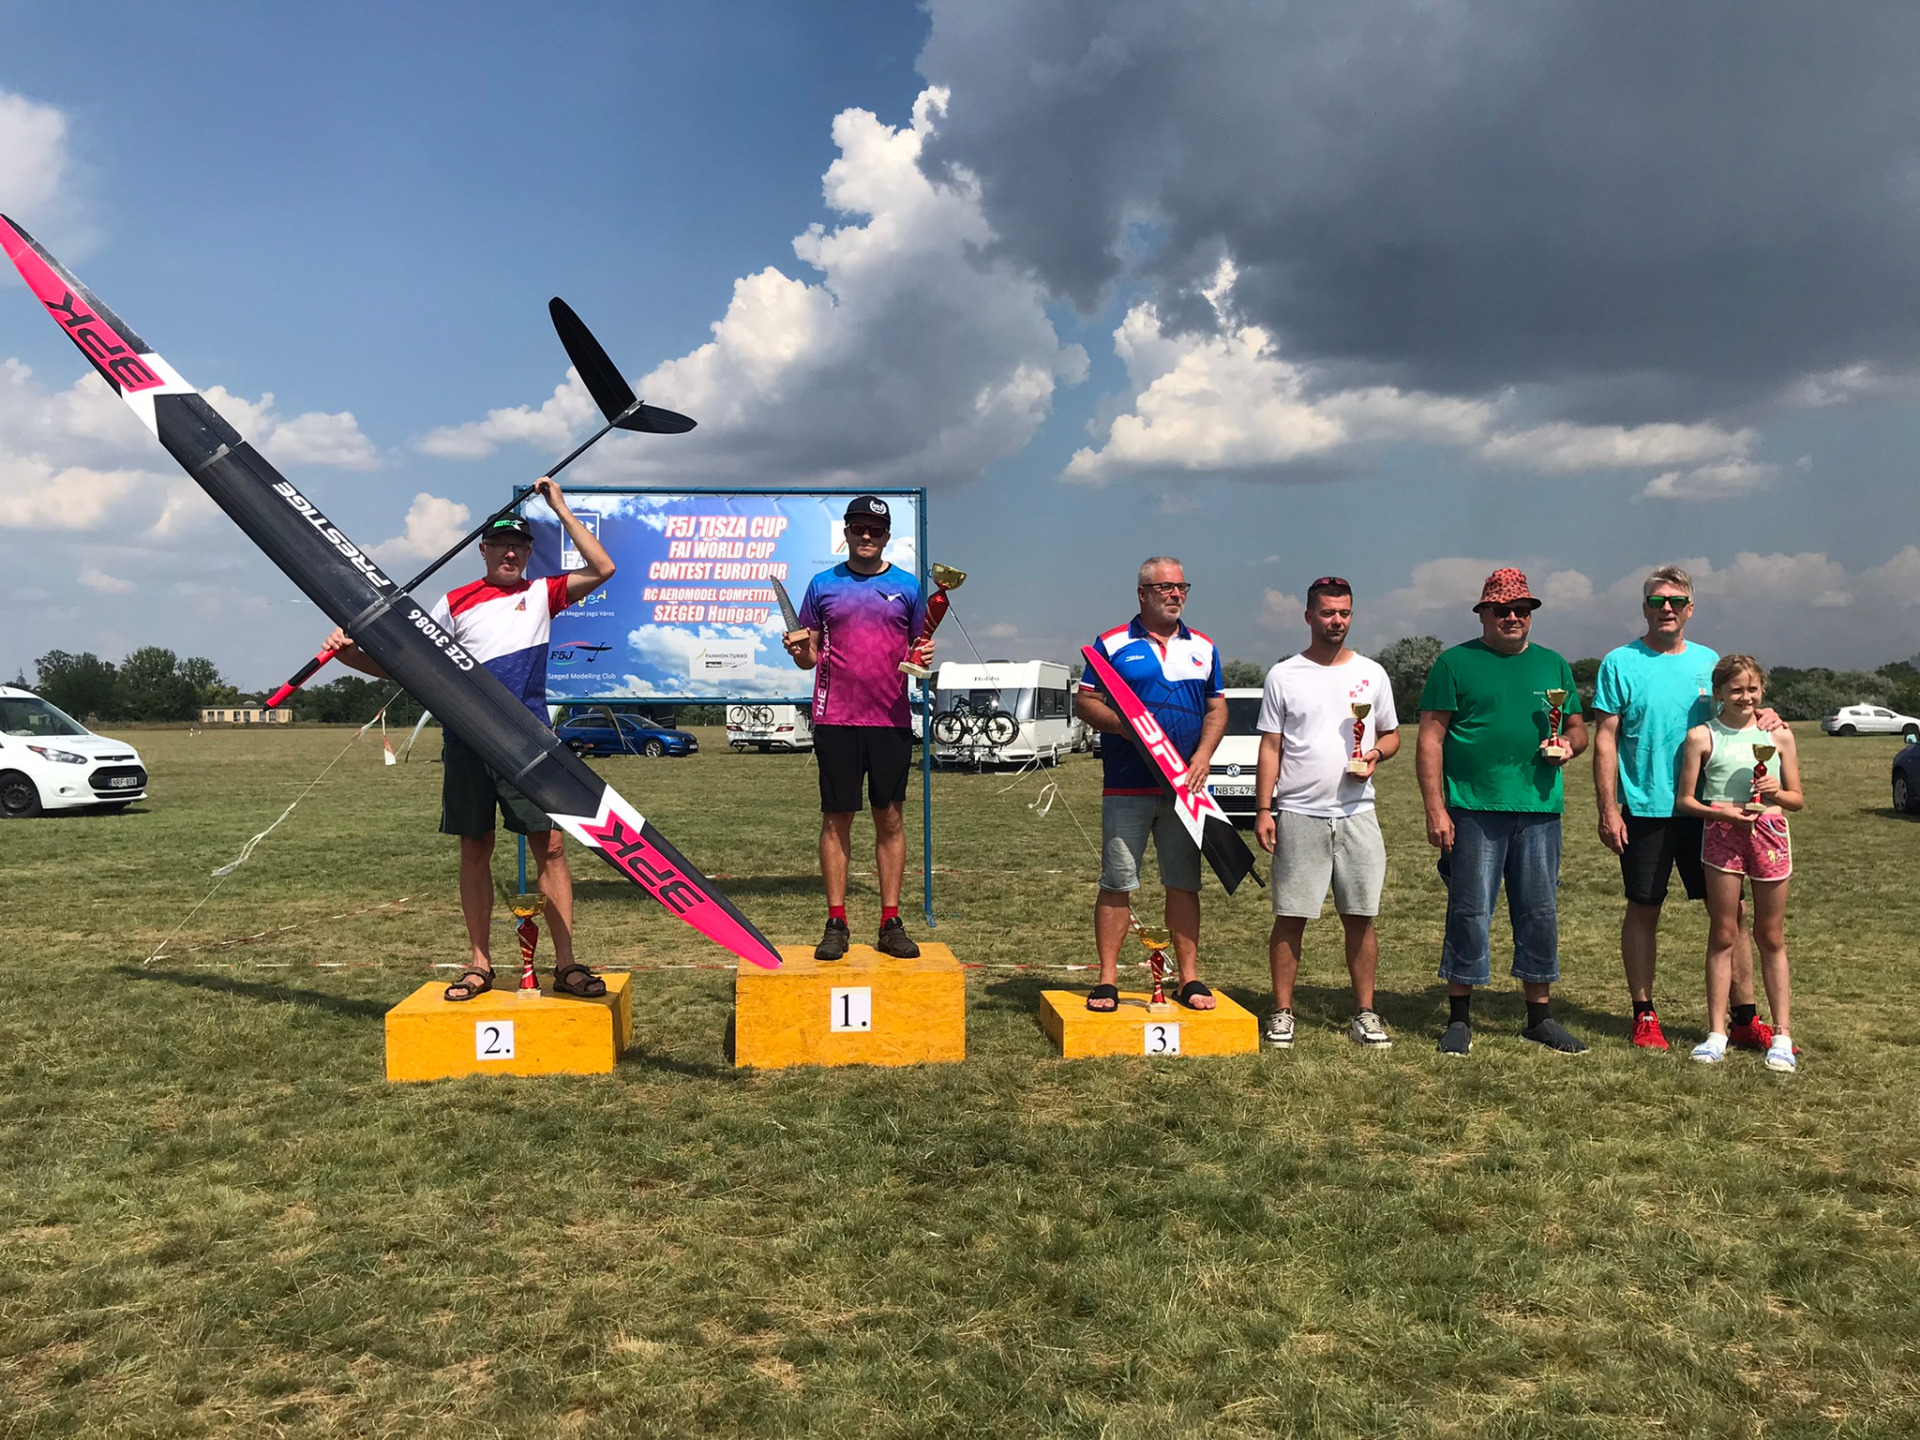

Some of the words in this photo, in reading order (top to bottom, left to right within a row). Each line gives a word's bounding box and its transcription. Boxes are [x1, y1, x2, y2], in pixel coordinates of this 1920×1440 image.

[272, 481, 392, 588] PRESTIGE
[665, 516, 697, 538] F5J
[698, 516, 747, 538] TISZA
[749, 516, 788, 539] CUP
[563, 553, 588, 568] FA
[668, 541, 692, 559] FAI
[693, 541, 744, 559] WORLD
[745, 541, 776, 559] CUP
[649, 562, 713, 580] CONTEST
[713, 562, 788, 581] EUROTOUR
[643, 588, 659, 601] RC
[659, 588, 717, 601] AEROMODEL
[718, 588, 778, 602] COMPETITIO
[653, 605, 706, 622] SZEGED
[707, 606, 770, 624] Hungary
[407, 609, 450, 648] 31086
[444, 642, 475, 671] CZE
[550, 650, 574, 660] F5J
[547, 673, 569, 681] Szeged
[570, 672, 601, 681] Modelling
[602, 672, 617, 680] Club
[840, 993, 867, 1027] 1.
[484, 1026, 511, 1054] 2.
[1152, 1026, 1177, 1052] 3.
